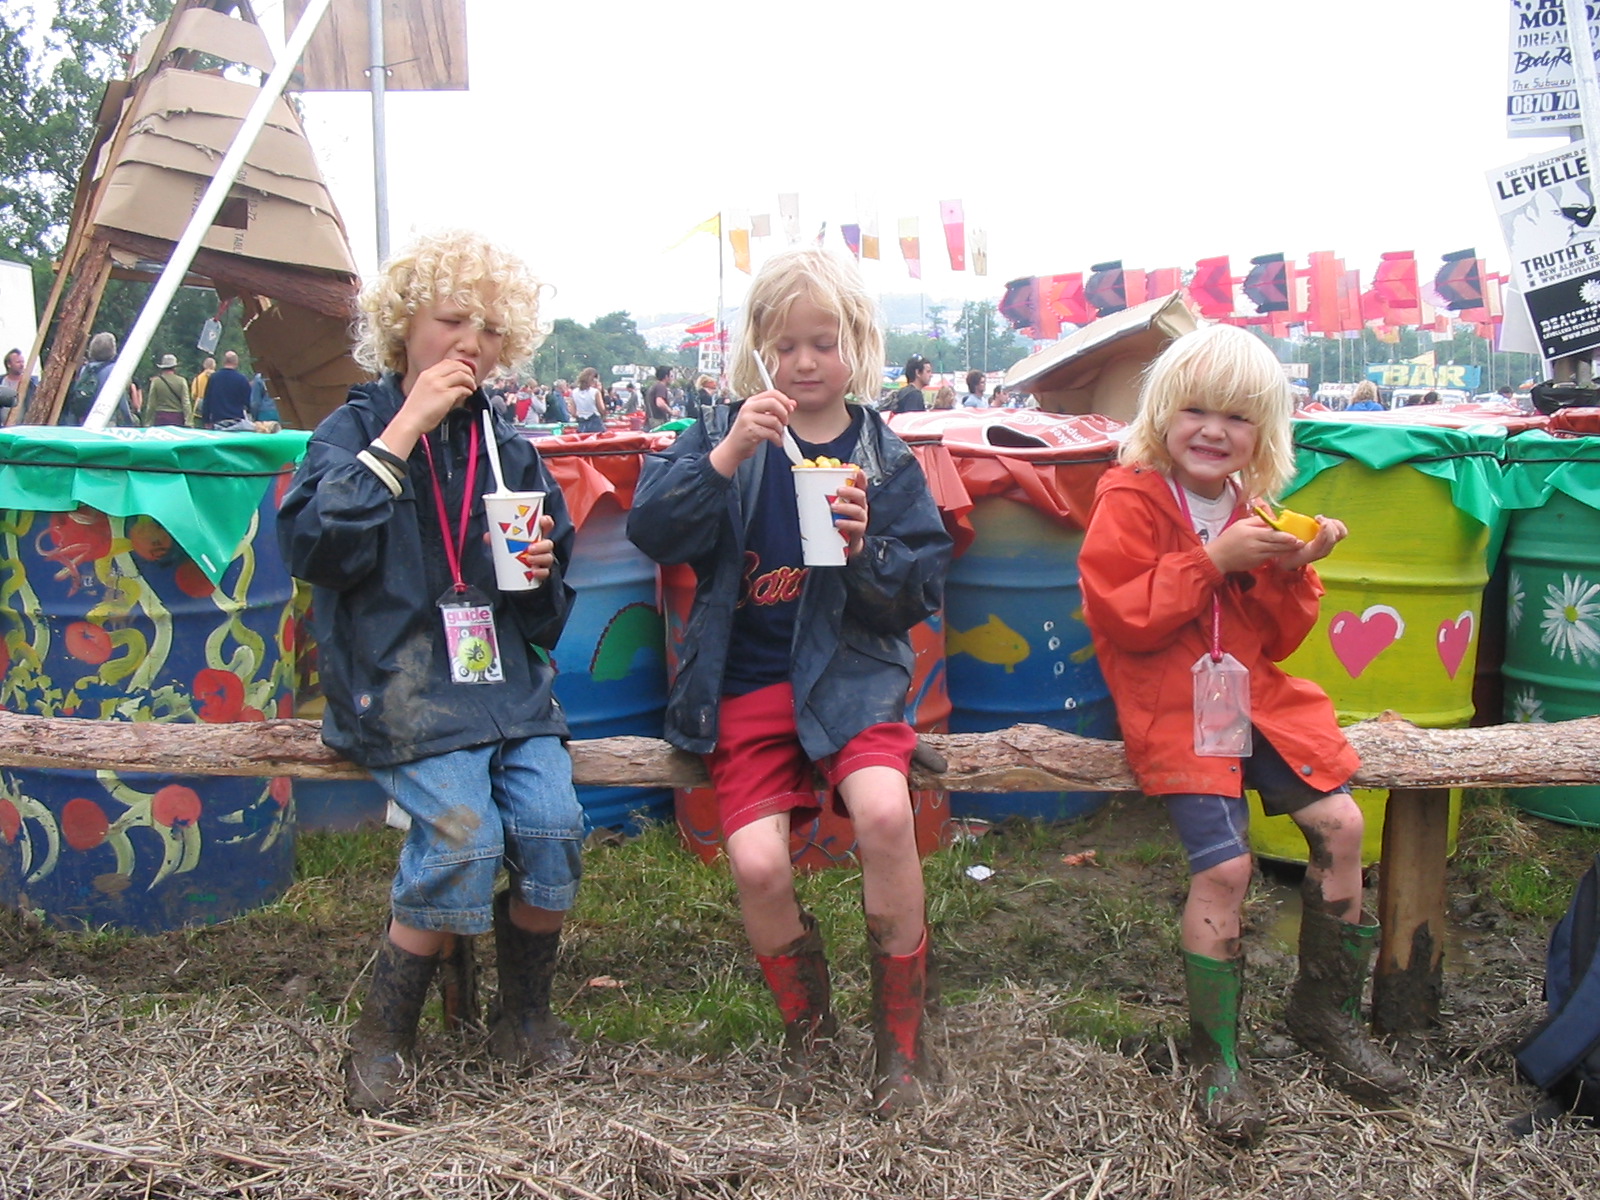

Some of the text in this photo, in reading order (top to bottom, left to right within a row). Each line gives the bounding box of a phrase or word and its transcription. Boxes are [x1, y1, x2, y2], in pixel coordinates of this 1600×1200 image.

[1513, 79, 1529, 90] The
[1511, 90, 1577, 114] 0870 70
[1504, 169, 1517, 178] SAT
[1520, 164, 1535, 174] 2PM
[1521, 241, 1595, 273] TRUTH &
[1368, 364, 1466, 387] BAR
[446, 608, 490, 624] guide
